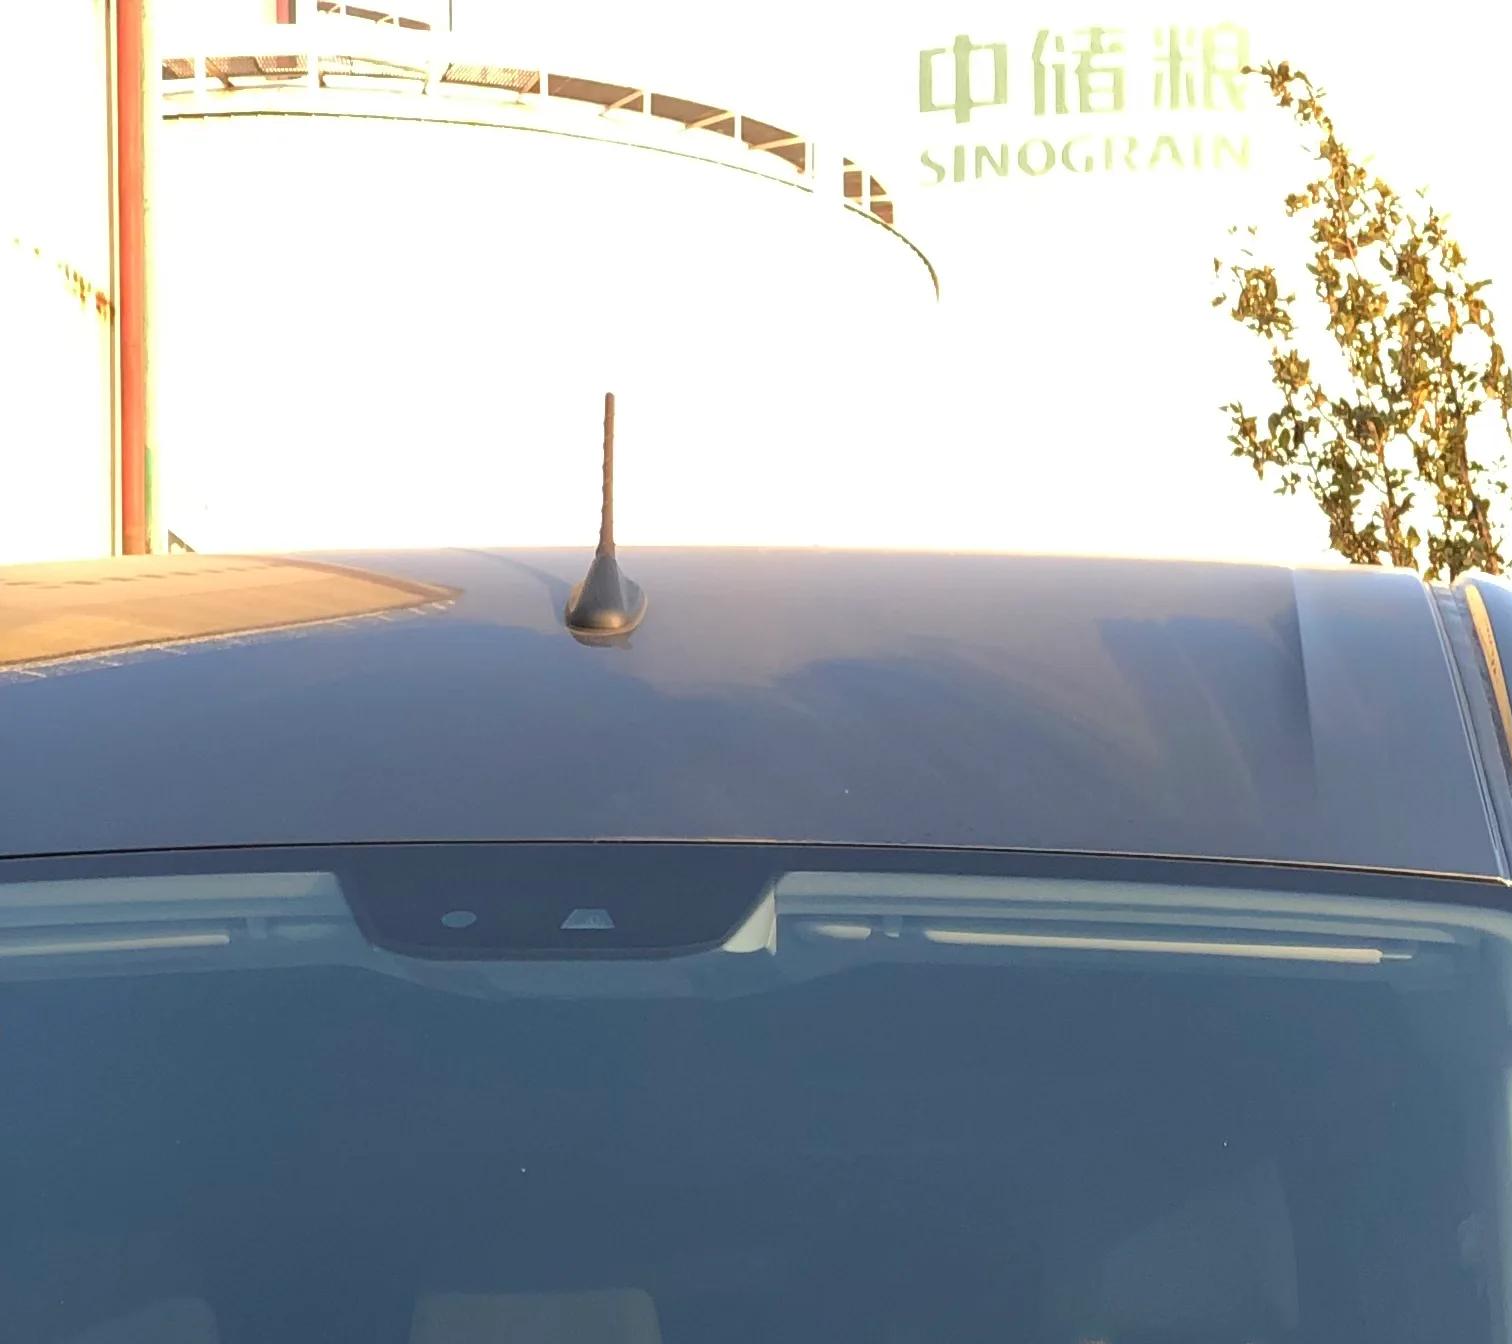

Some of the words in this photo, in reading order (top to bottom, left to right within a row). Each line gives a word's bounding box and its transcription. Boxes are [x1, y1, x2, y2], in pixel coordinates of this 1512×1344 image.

[919, 22, 1251, 124] 中储粮
[919, 134, 1251, 187] SINOGRAIN
